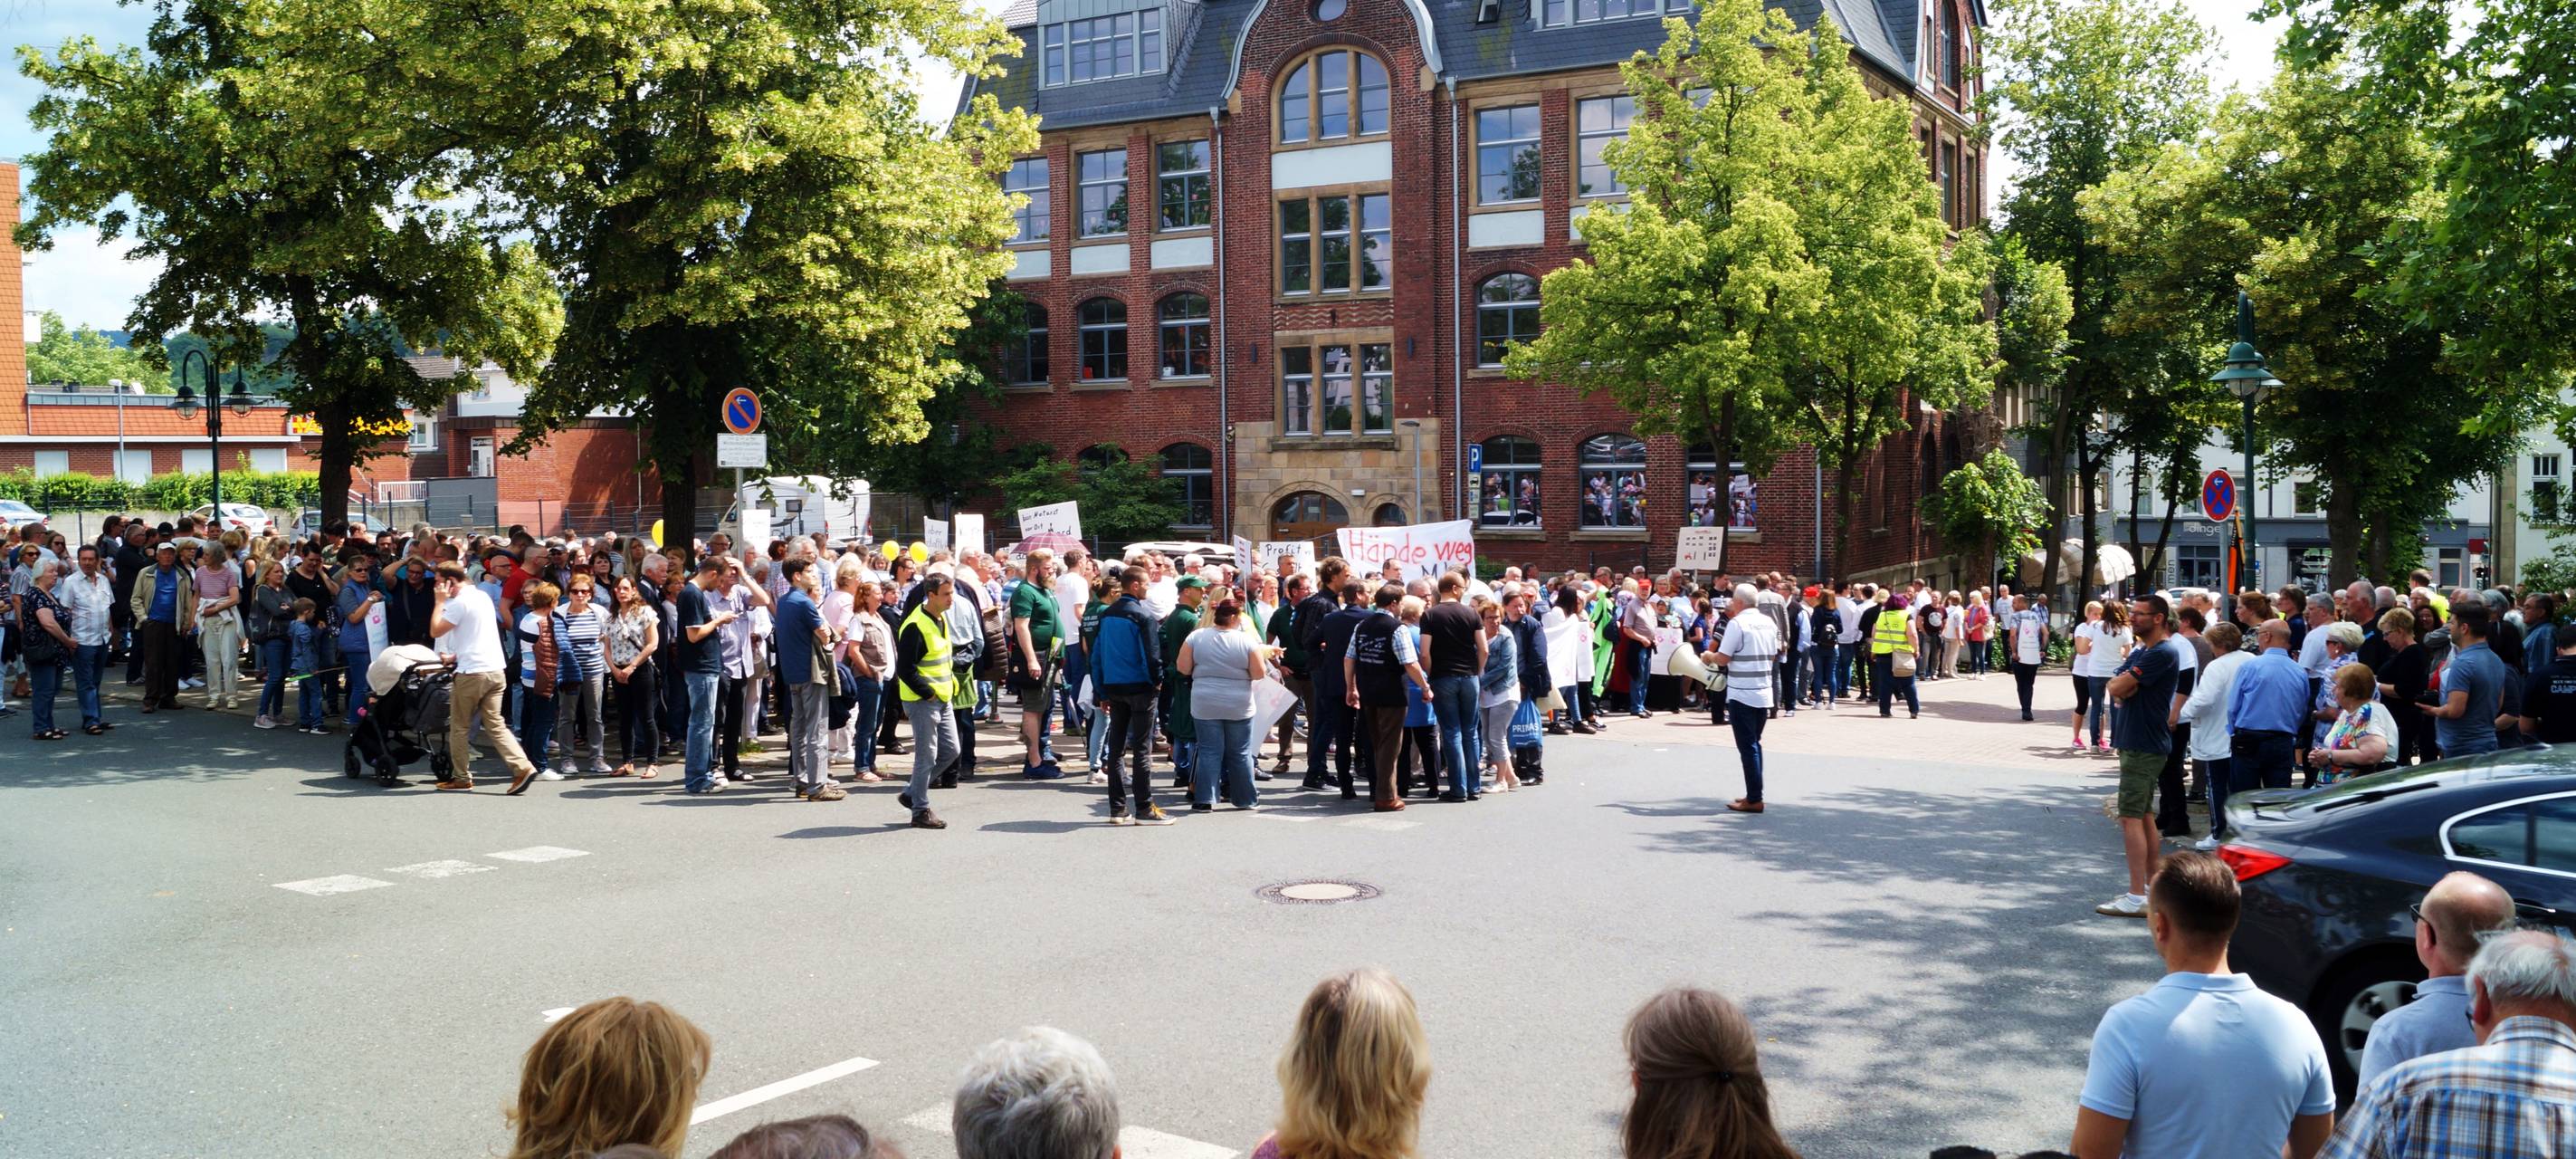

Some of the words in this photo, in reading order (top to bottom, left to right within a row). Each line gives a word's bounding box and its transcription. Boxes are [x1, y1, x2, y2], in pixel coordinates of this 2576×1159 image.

[1471, 448, 1479, 470] P
[1265, 543, 1301, 556] Profit
[1349, 530, 1426, 564] Hände
[1434, 541, 1473, 567] weg
